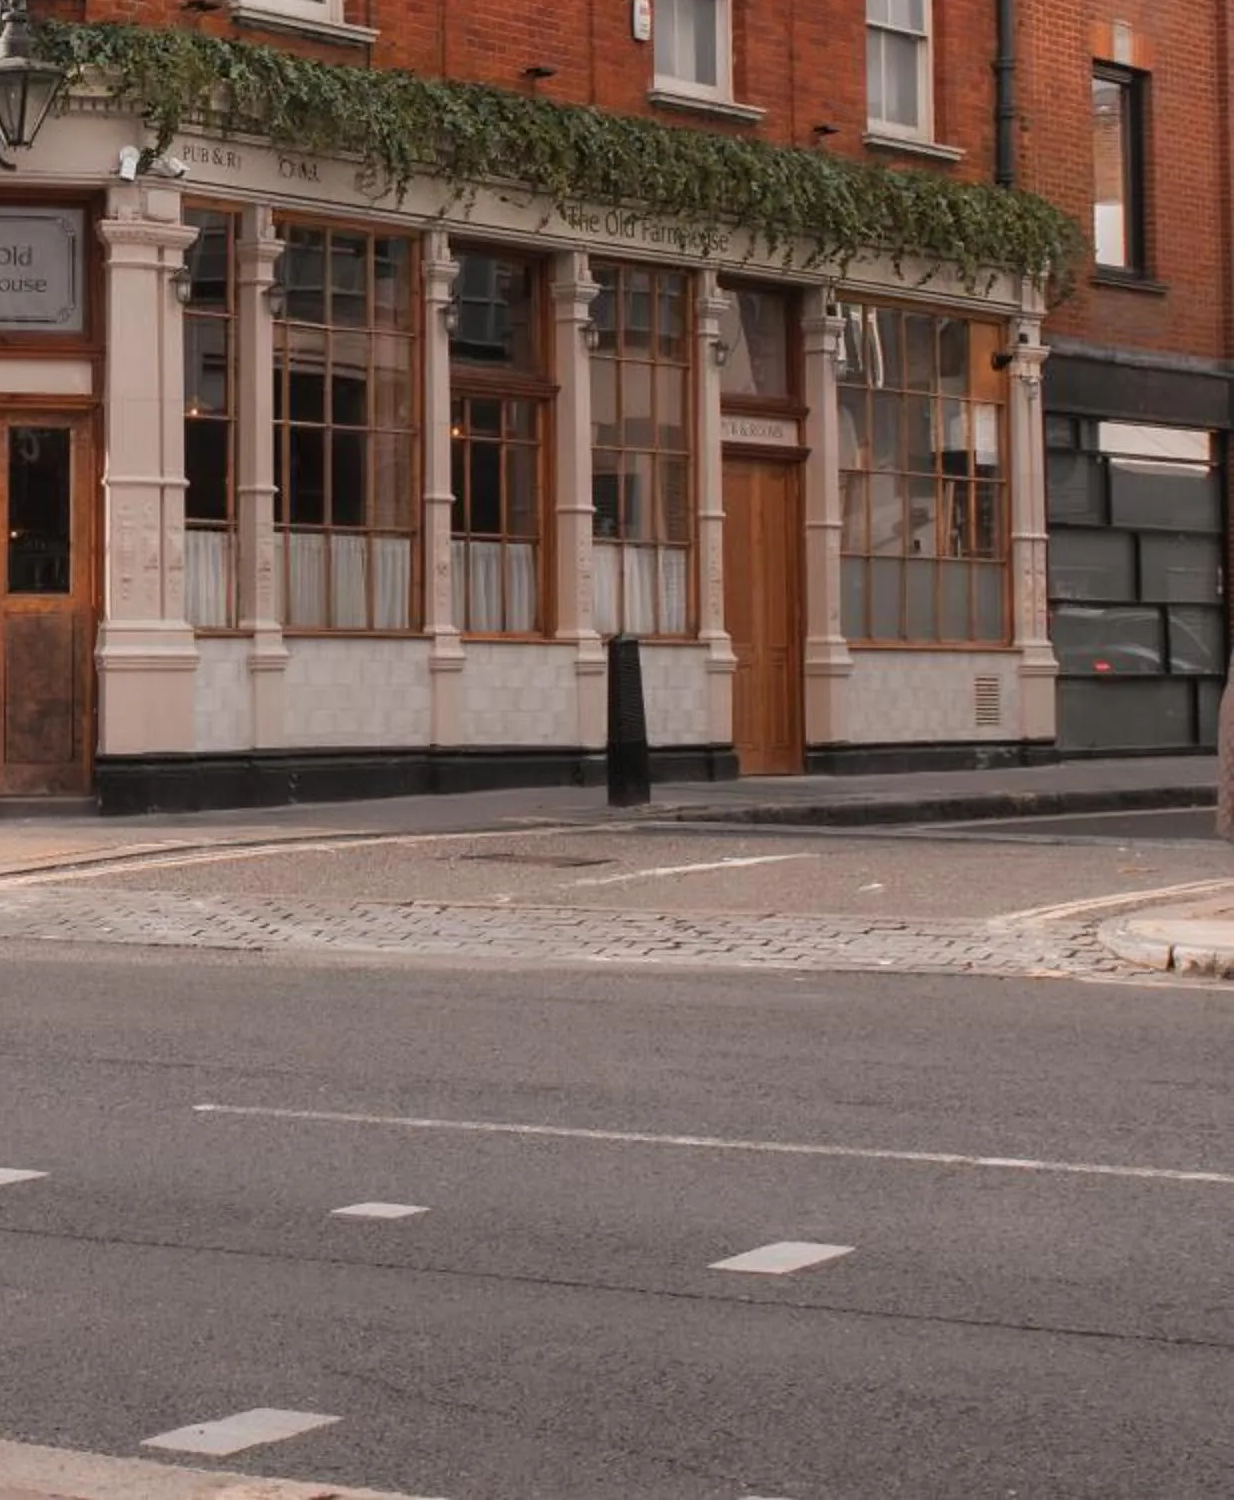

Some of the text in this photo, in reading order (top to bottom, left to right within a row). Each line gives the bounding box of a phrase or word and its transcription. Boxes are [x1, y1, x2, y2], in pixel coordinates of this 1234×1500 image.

[182, 145, 226, 166] PUB &
[567, 203, 730, 251] The Old Farmuse
